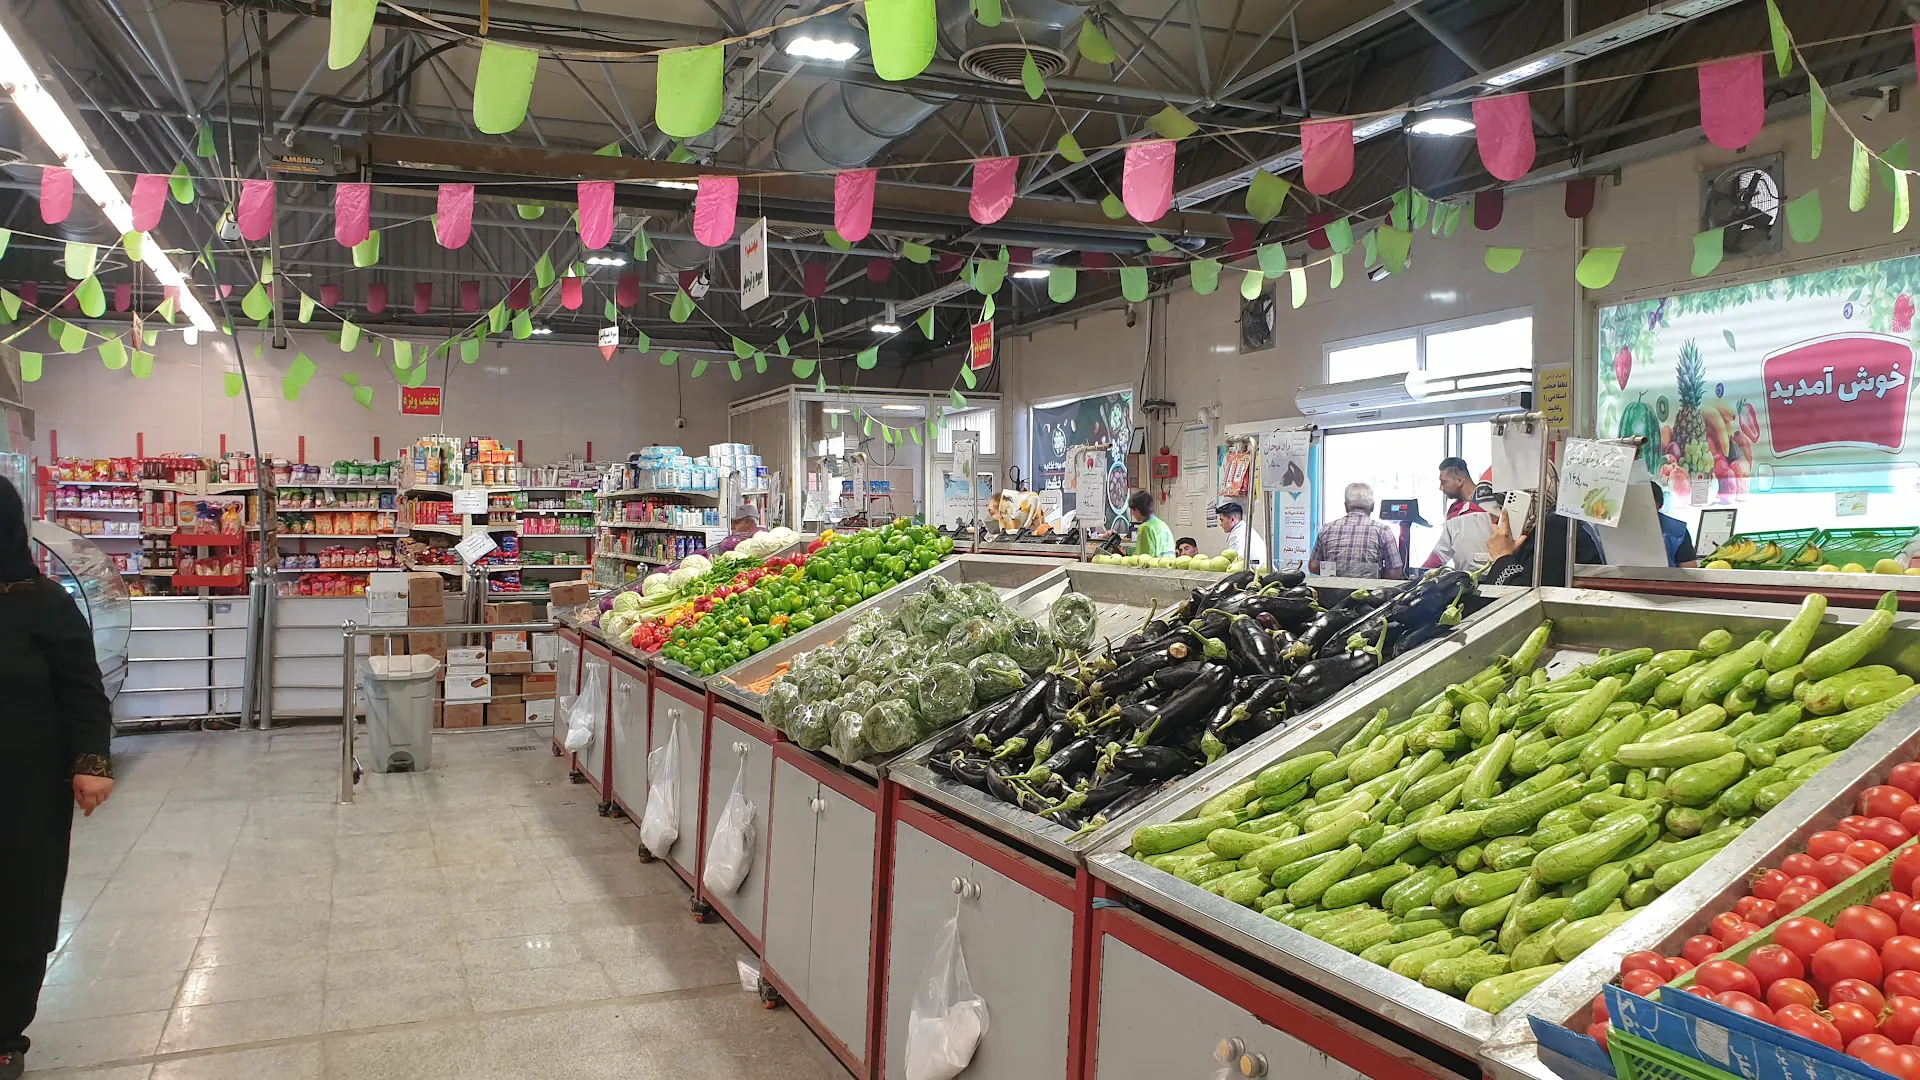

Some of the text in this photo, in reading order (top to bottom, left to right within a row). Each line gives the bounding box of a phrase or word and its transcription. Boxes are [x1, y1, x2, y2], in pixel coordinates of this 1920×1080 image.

[282, 156, 324, 165] AMBIRAD
[1770, 362, 1906, 405] خوش آمدید
[403, 393, 439, 410] تخفیف ویژه
[1548, 392, 1567, 402] اسلامی
